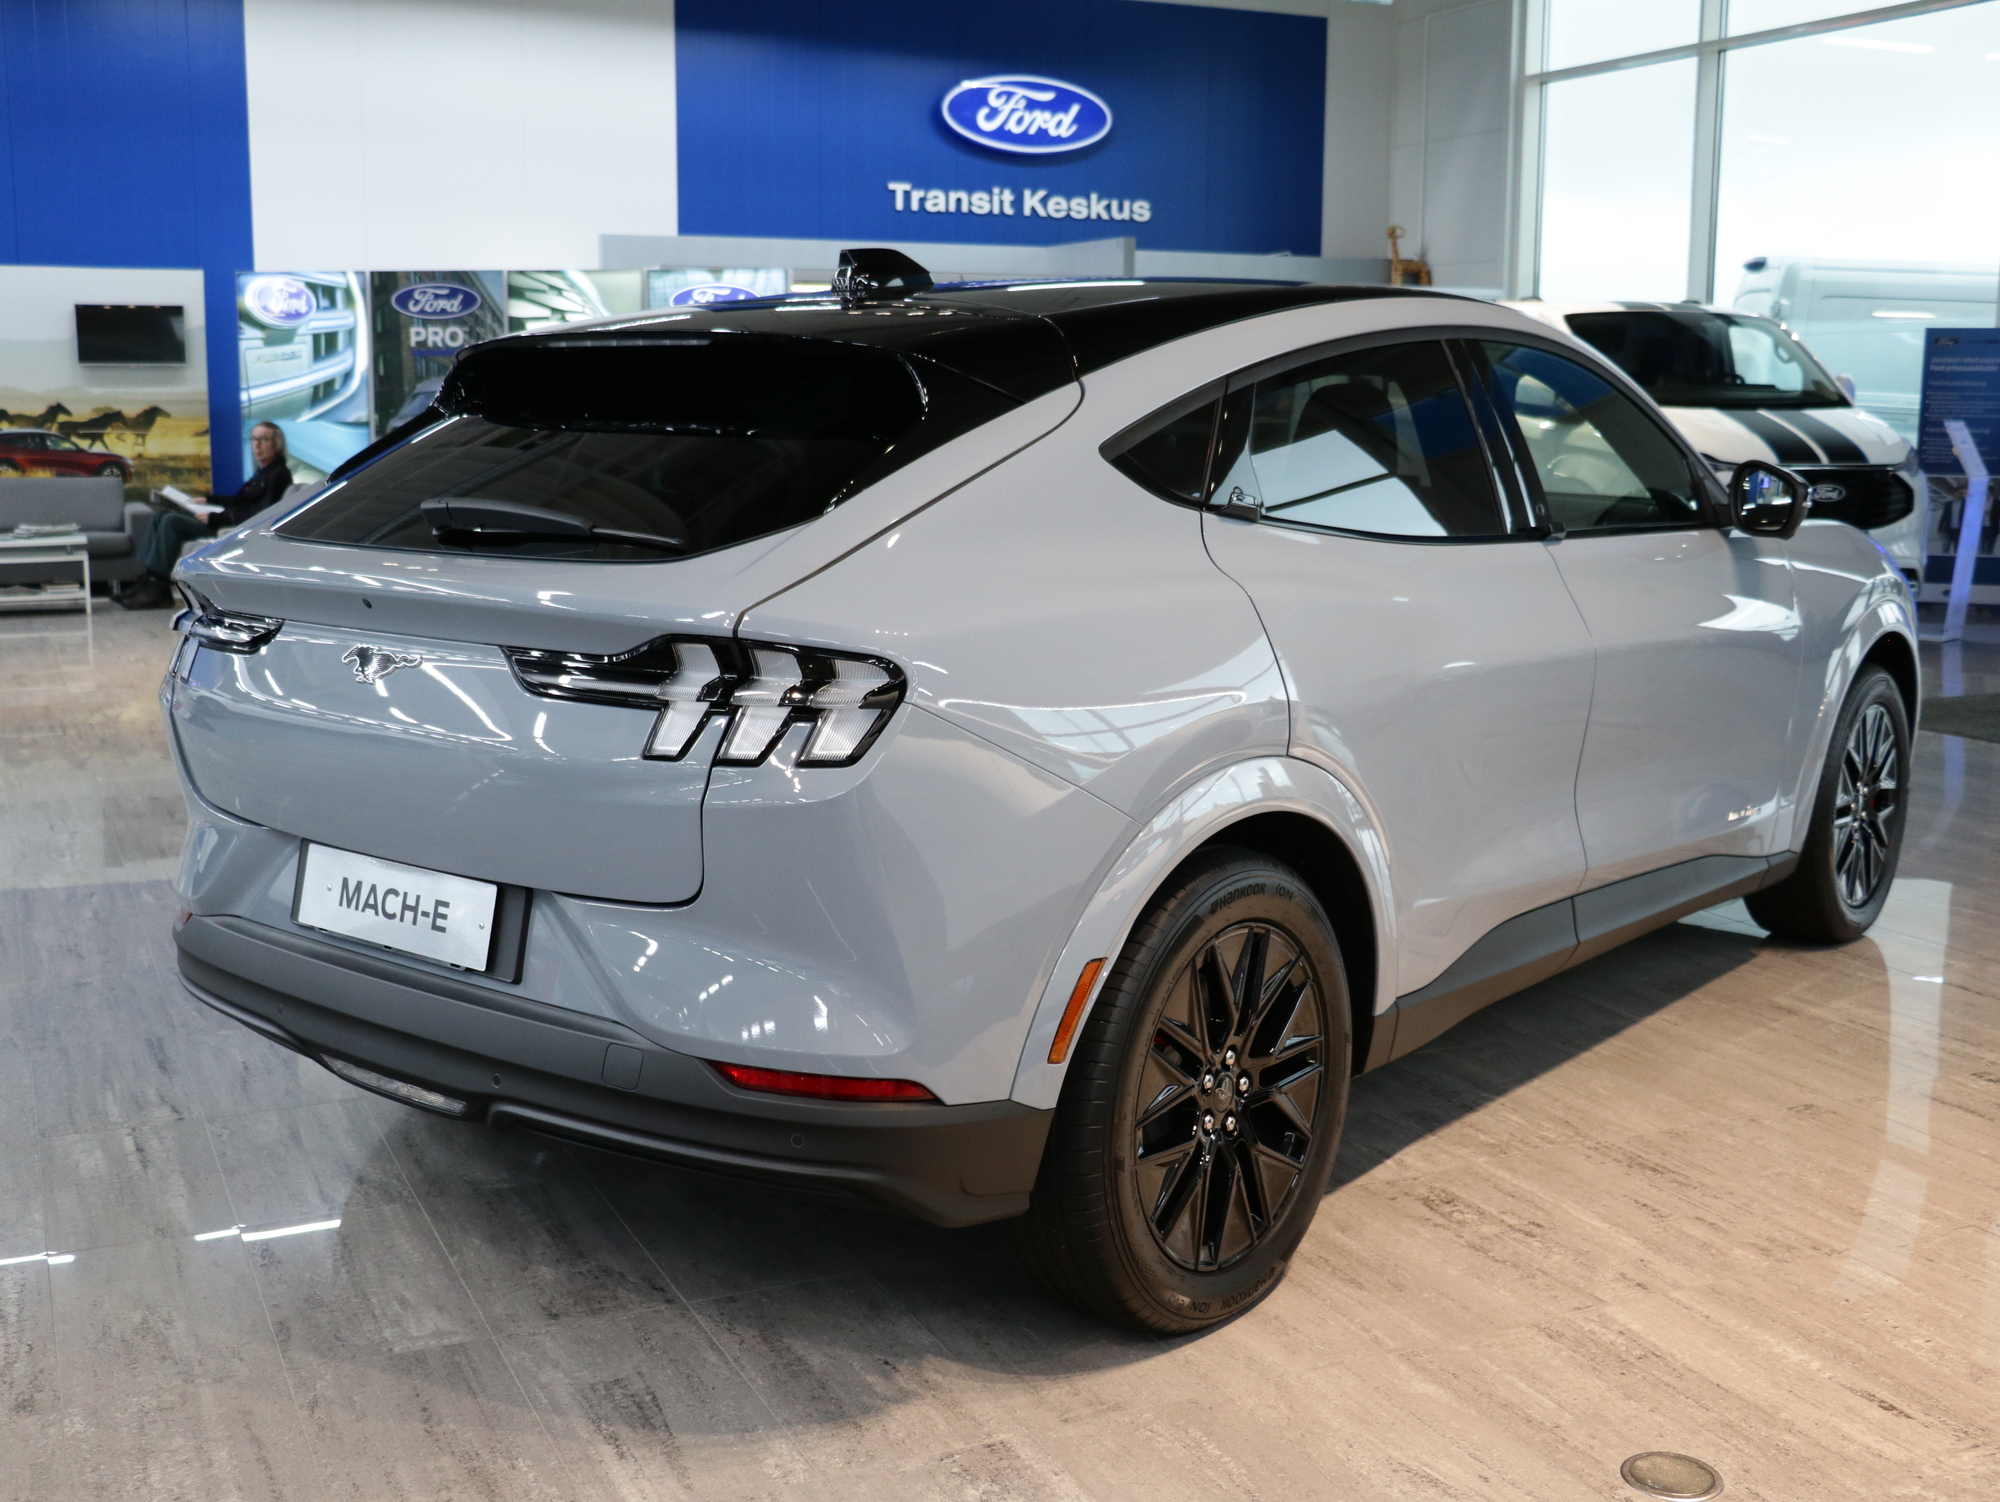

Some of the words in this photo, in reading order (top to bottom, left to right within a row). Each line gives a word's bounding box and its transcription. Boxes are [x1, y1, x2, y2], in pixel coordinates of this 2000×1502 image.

[976, 85, 1082, 139] Ford
[887, 181, 1015, 216] Transit
[1022, 188, 1152, 223] Keskus
[408, 287, 464, 314] Ford
[409, 326, 465, 348] PRO
[338, 876, 451, 934] MACH-E
